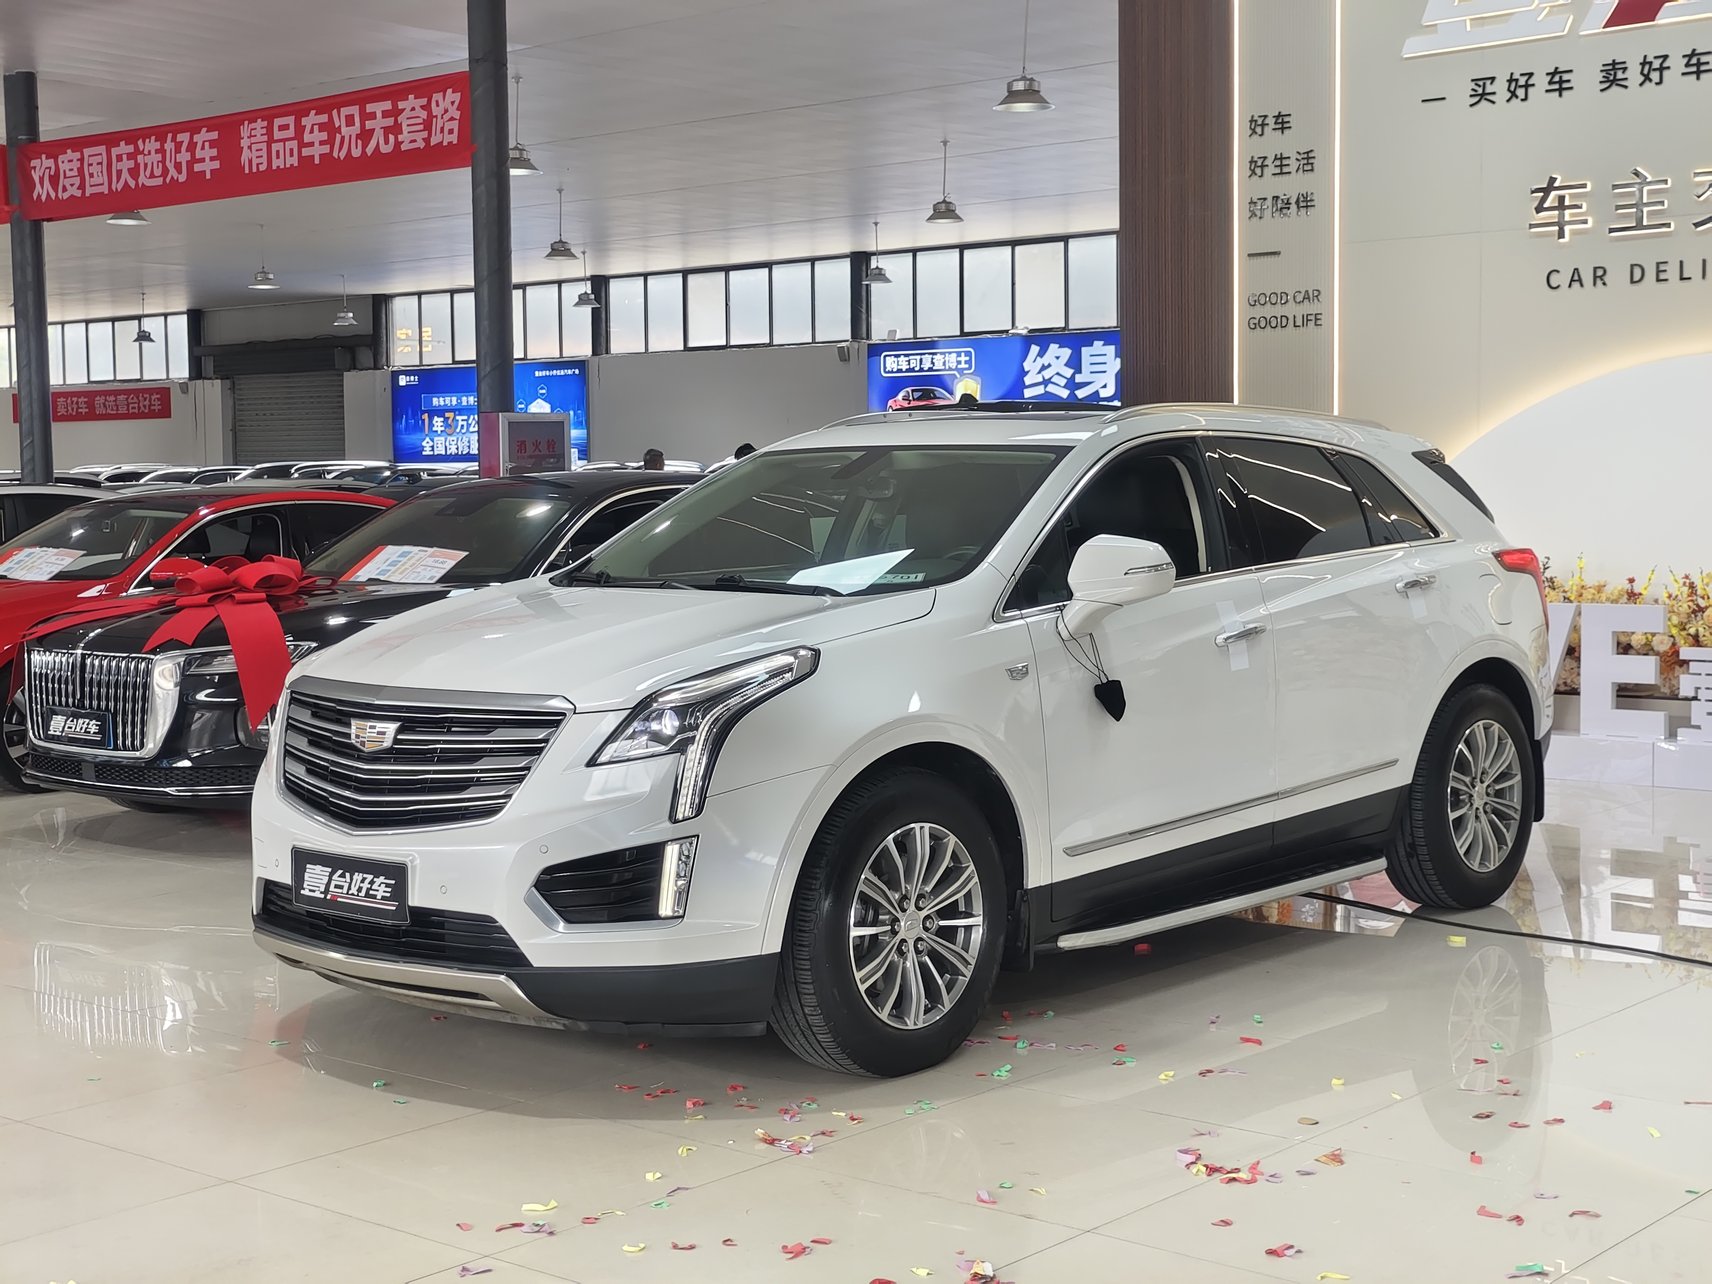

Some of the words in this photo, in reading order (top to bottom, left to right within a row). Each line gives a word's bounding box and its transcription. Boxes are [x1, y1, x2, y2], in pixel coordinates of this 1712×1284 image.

[1469, 66, 1574, 108] 买好车
[1599, 48, 1712, 92] 卖好车
[1248, 111, 1292, 138] 好车
[30, 128, 221, 203] 欢度国庆选好车
[240, 88, 462, 174] 精品车况无套路
[1248, 149, 1316, 179] 好生活
[1248, 191, 1316, 220] 好陪伴
[1546, 265, 1608, 291] CAR
[1629, 258, 1707, 285] DELI
[1247, 291, 1289, 307] GOOD
[1293, 289, 1322, 304] CAR
[1247, 315, 1289, 330] GOOD
[1293, 313, 1323, 329] LIFE
[885, 353, 970, 372] 购车可享查博士
[1023, 340, 1121, 399] 终身
[57, 397, 89, 416] 卖好车
[95, 393, 162, 415] 就选壹台好车
[516, 439, 557, 454] 消火栓
[48, 714, 101, 736] 壹台好车
[300, 863, 396, 900] 壹台好车
